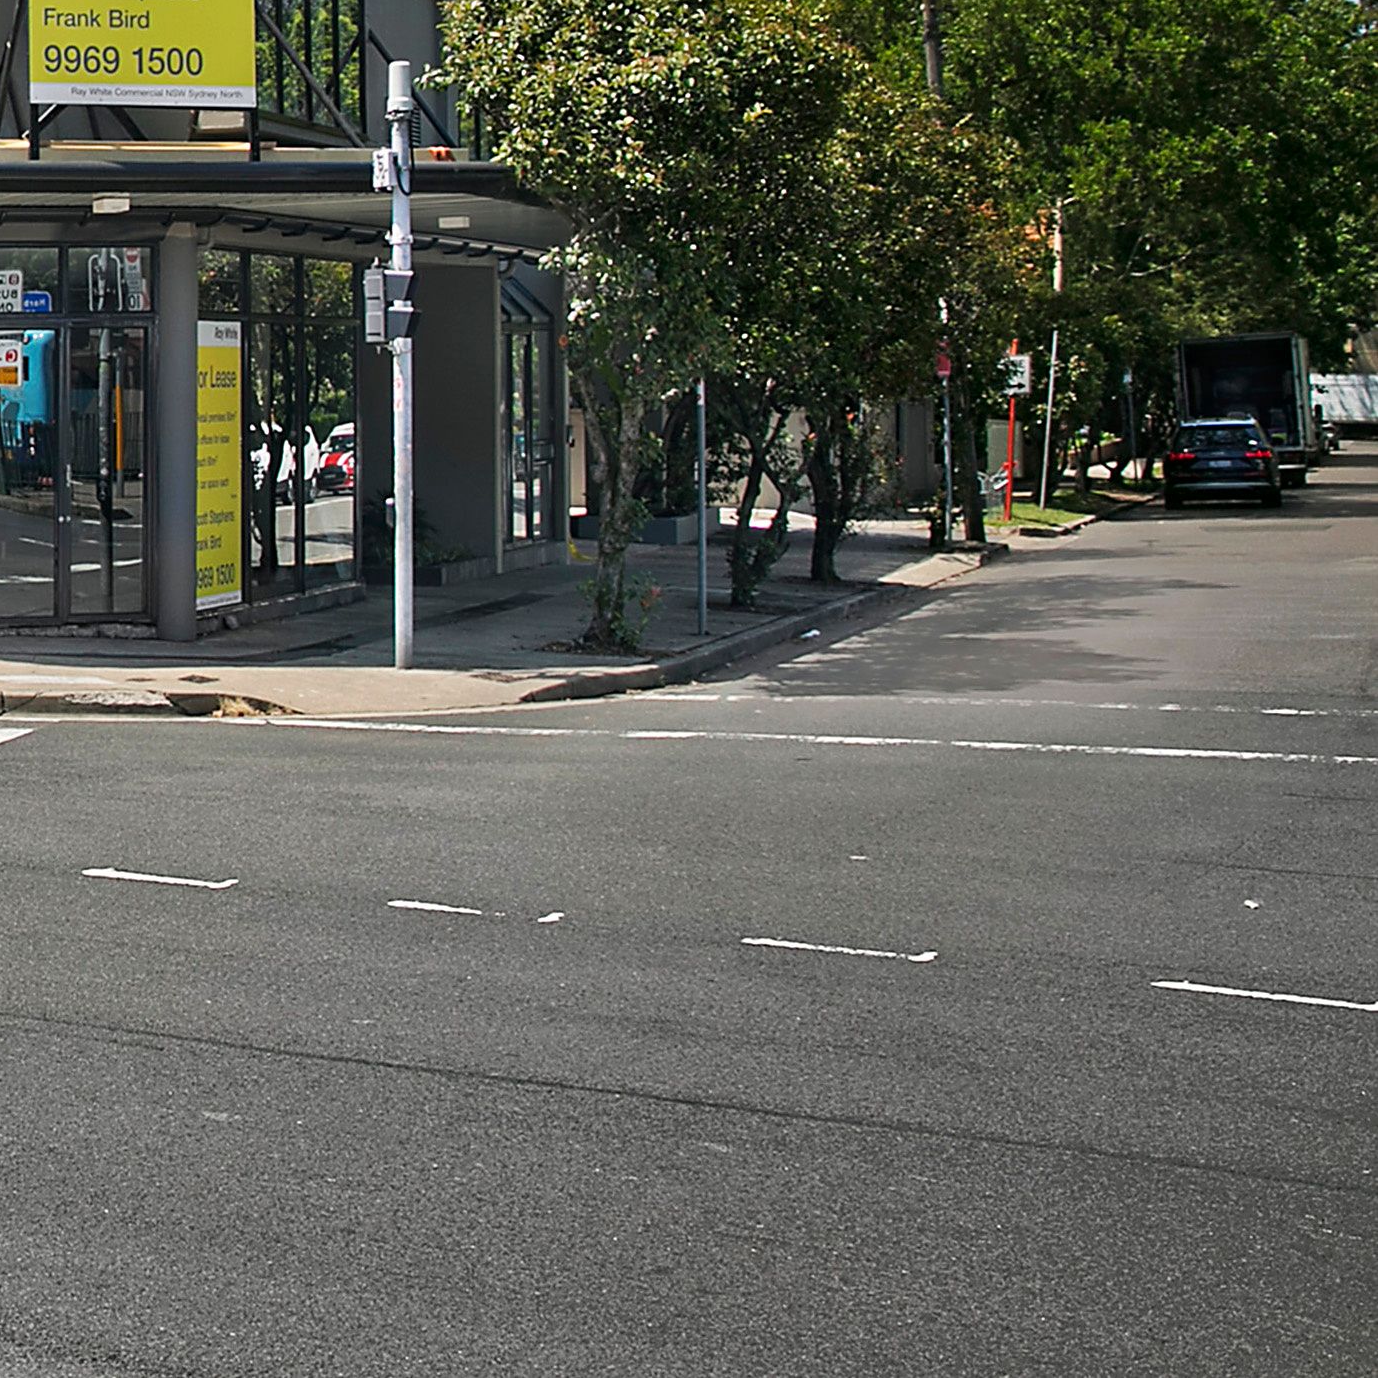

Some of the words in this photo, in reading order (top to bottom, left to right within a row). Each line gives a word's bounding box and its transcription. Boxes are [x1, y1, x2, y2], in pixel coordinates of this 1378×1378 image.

[43, 8, 101, 28] Frank
[109, 10, 150, 29] Bird
[44, 44, 120, 74] 9969
[132, 47, 204, 76] 1500
[71, 87, 86, 97] Ray
[90, 87, 113, 96] White
[114, 88, 164, 97] Commercial
[165, 89, 186, 98] NSW
[188, 90, 218, 99] Sydney
[220, 91, 243, 99] North
[210, 365, 237, 389] Lease
[216, 563, 235, 586] 1500
